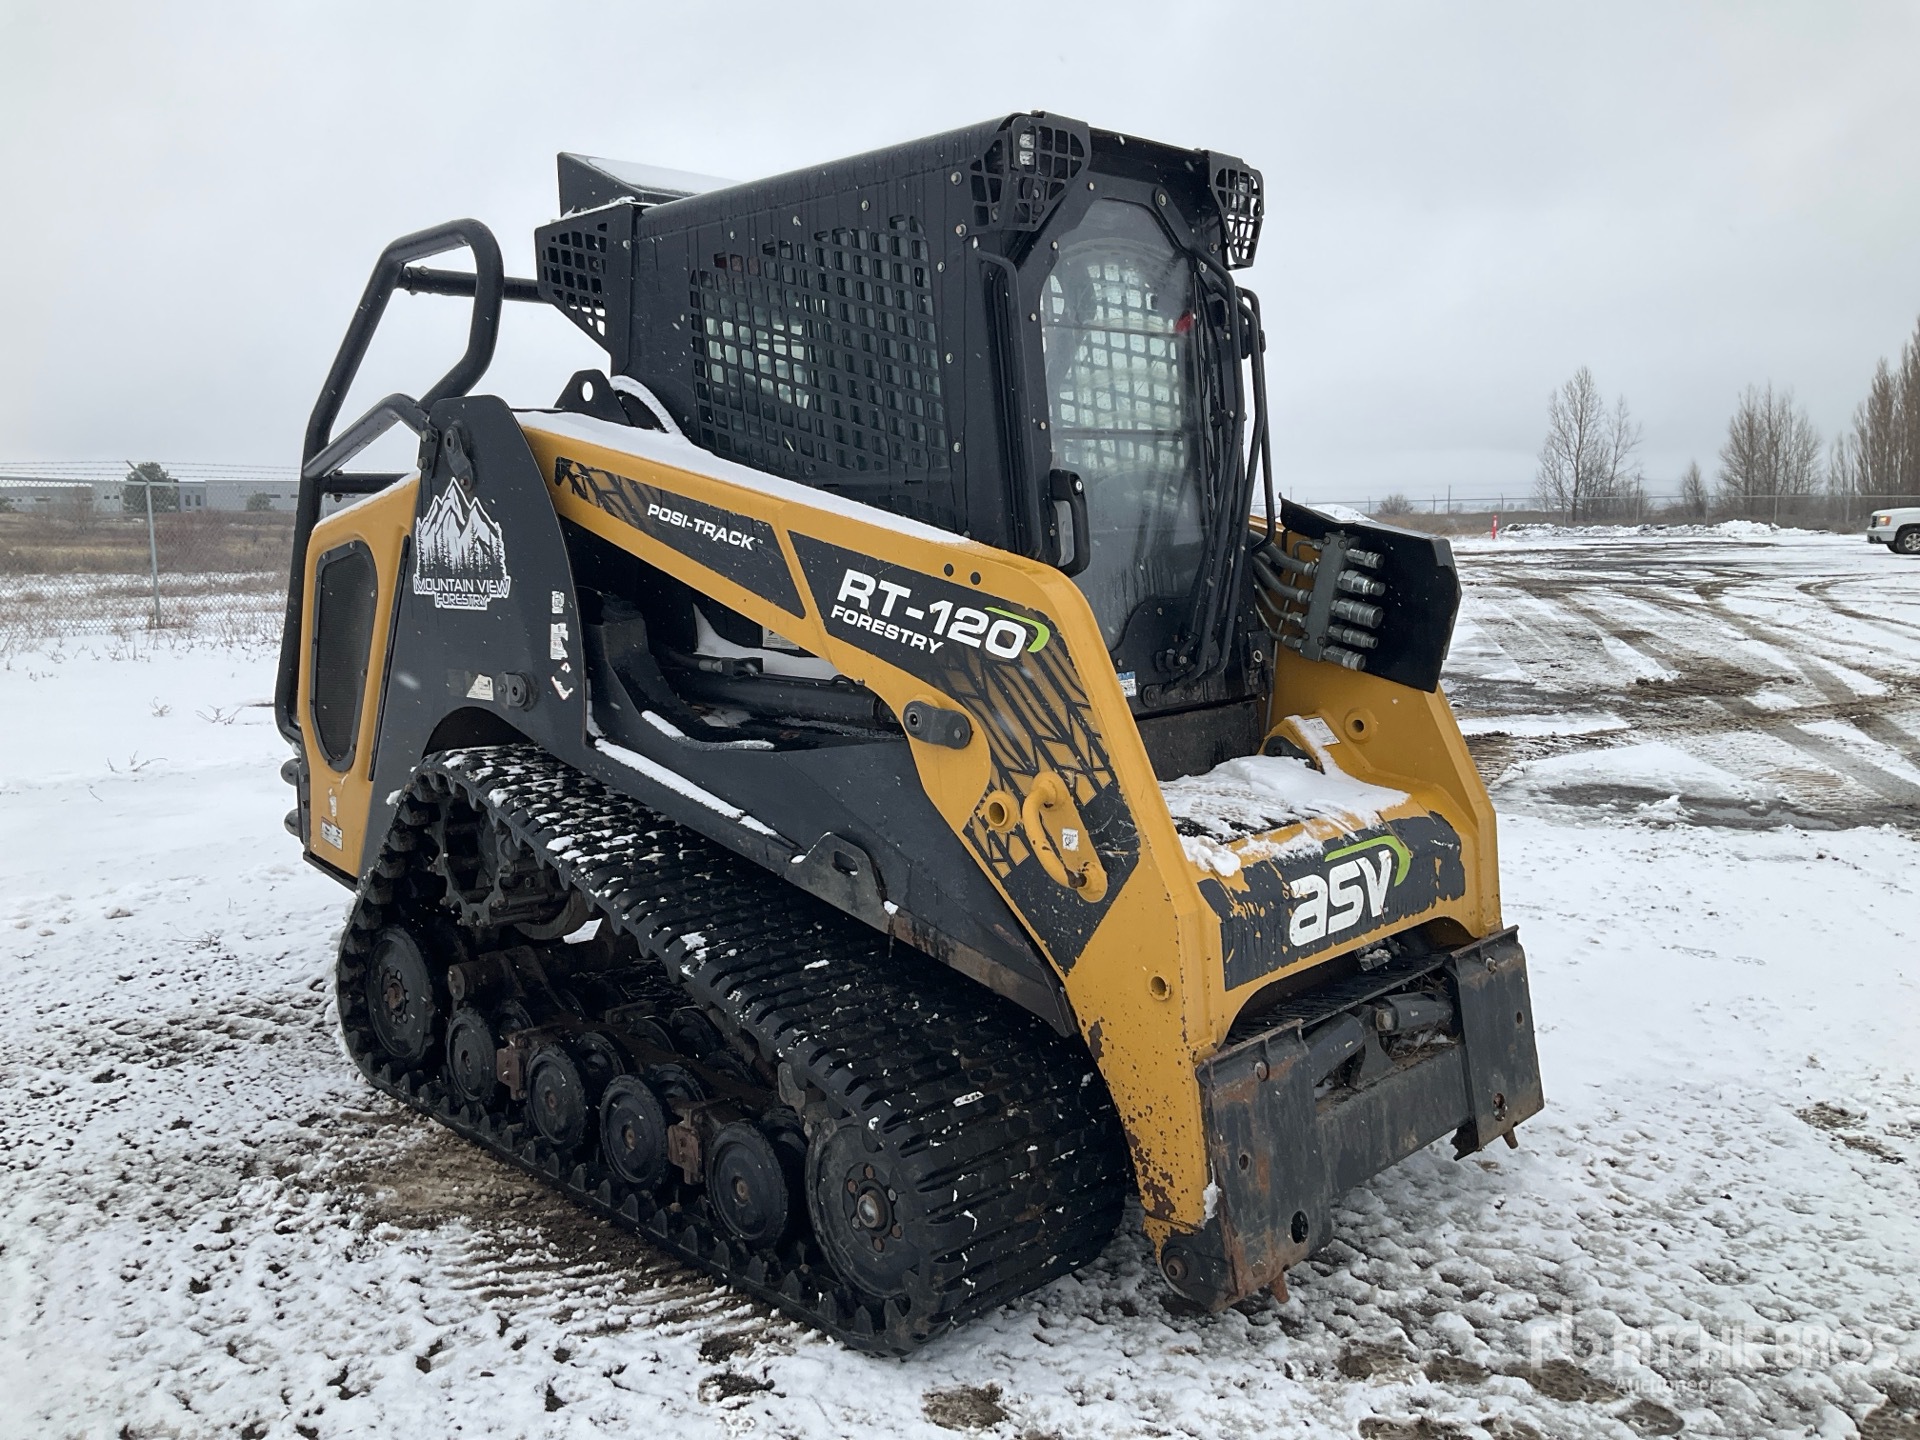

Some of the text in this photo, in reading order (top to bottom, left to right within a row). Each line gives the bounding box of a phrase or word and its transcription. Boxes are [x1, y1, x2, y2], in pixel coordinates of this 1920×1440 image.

[647, 503, 756, 550] POSI-TRACK
[415, 577, 509, 596] MOUNTAIN VIEW
[435, 593, 488, 607] FORESTRY
[830, 604, 945, 654] FORESTRY
[836, 568, 1027, 659] RT-120
